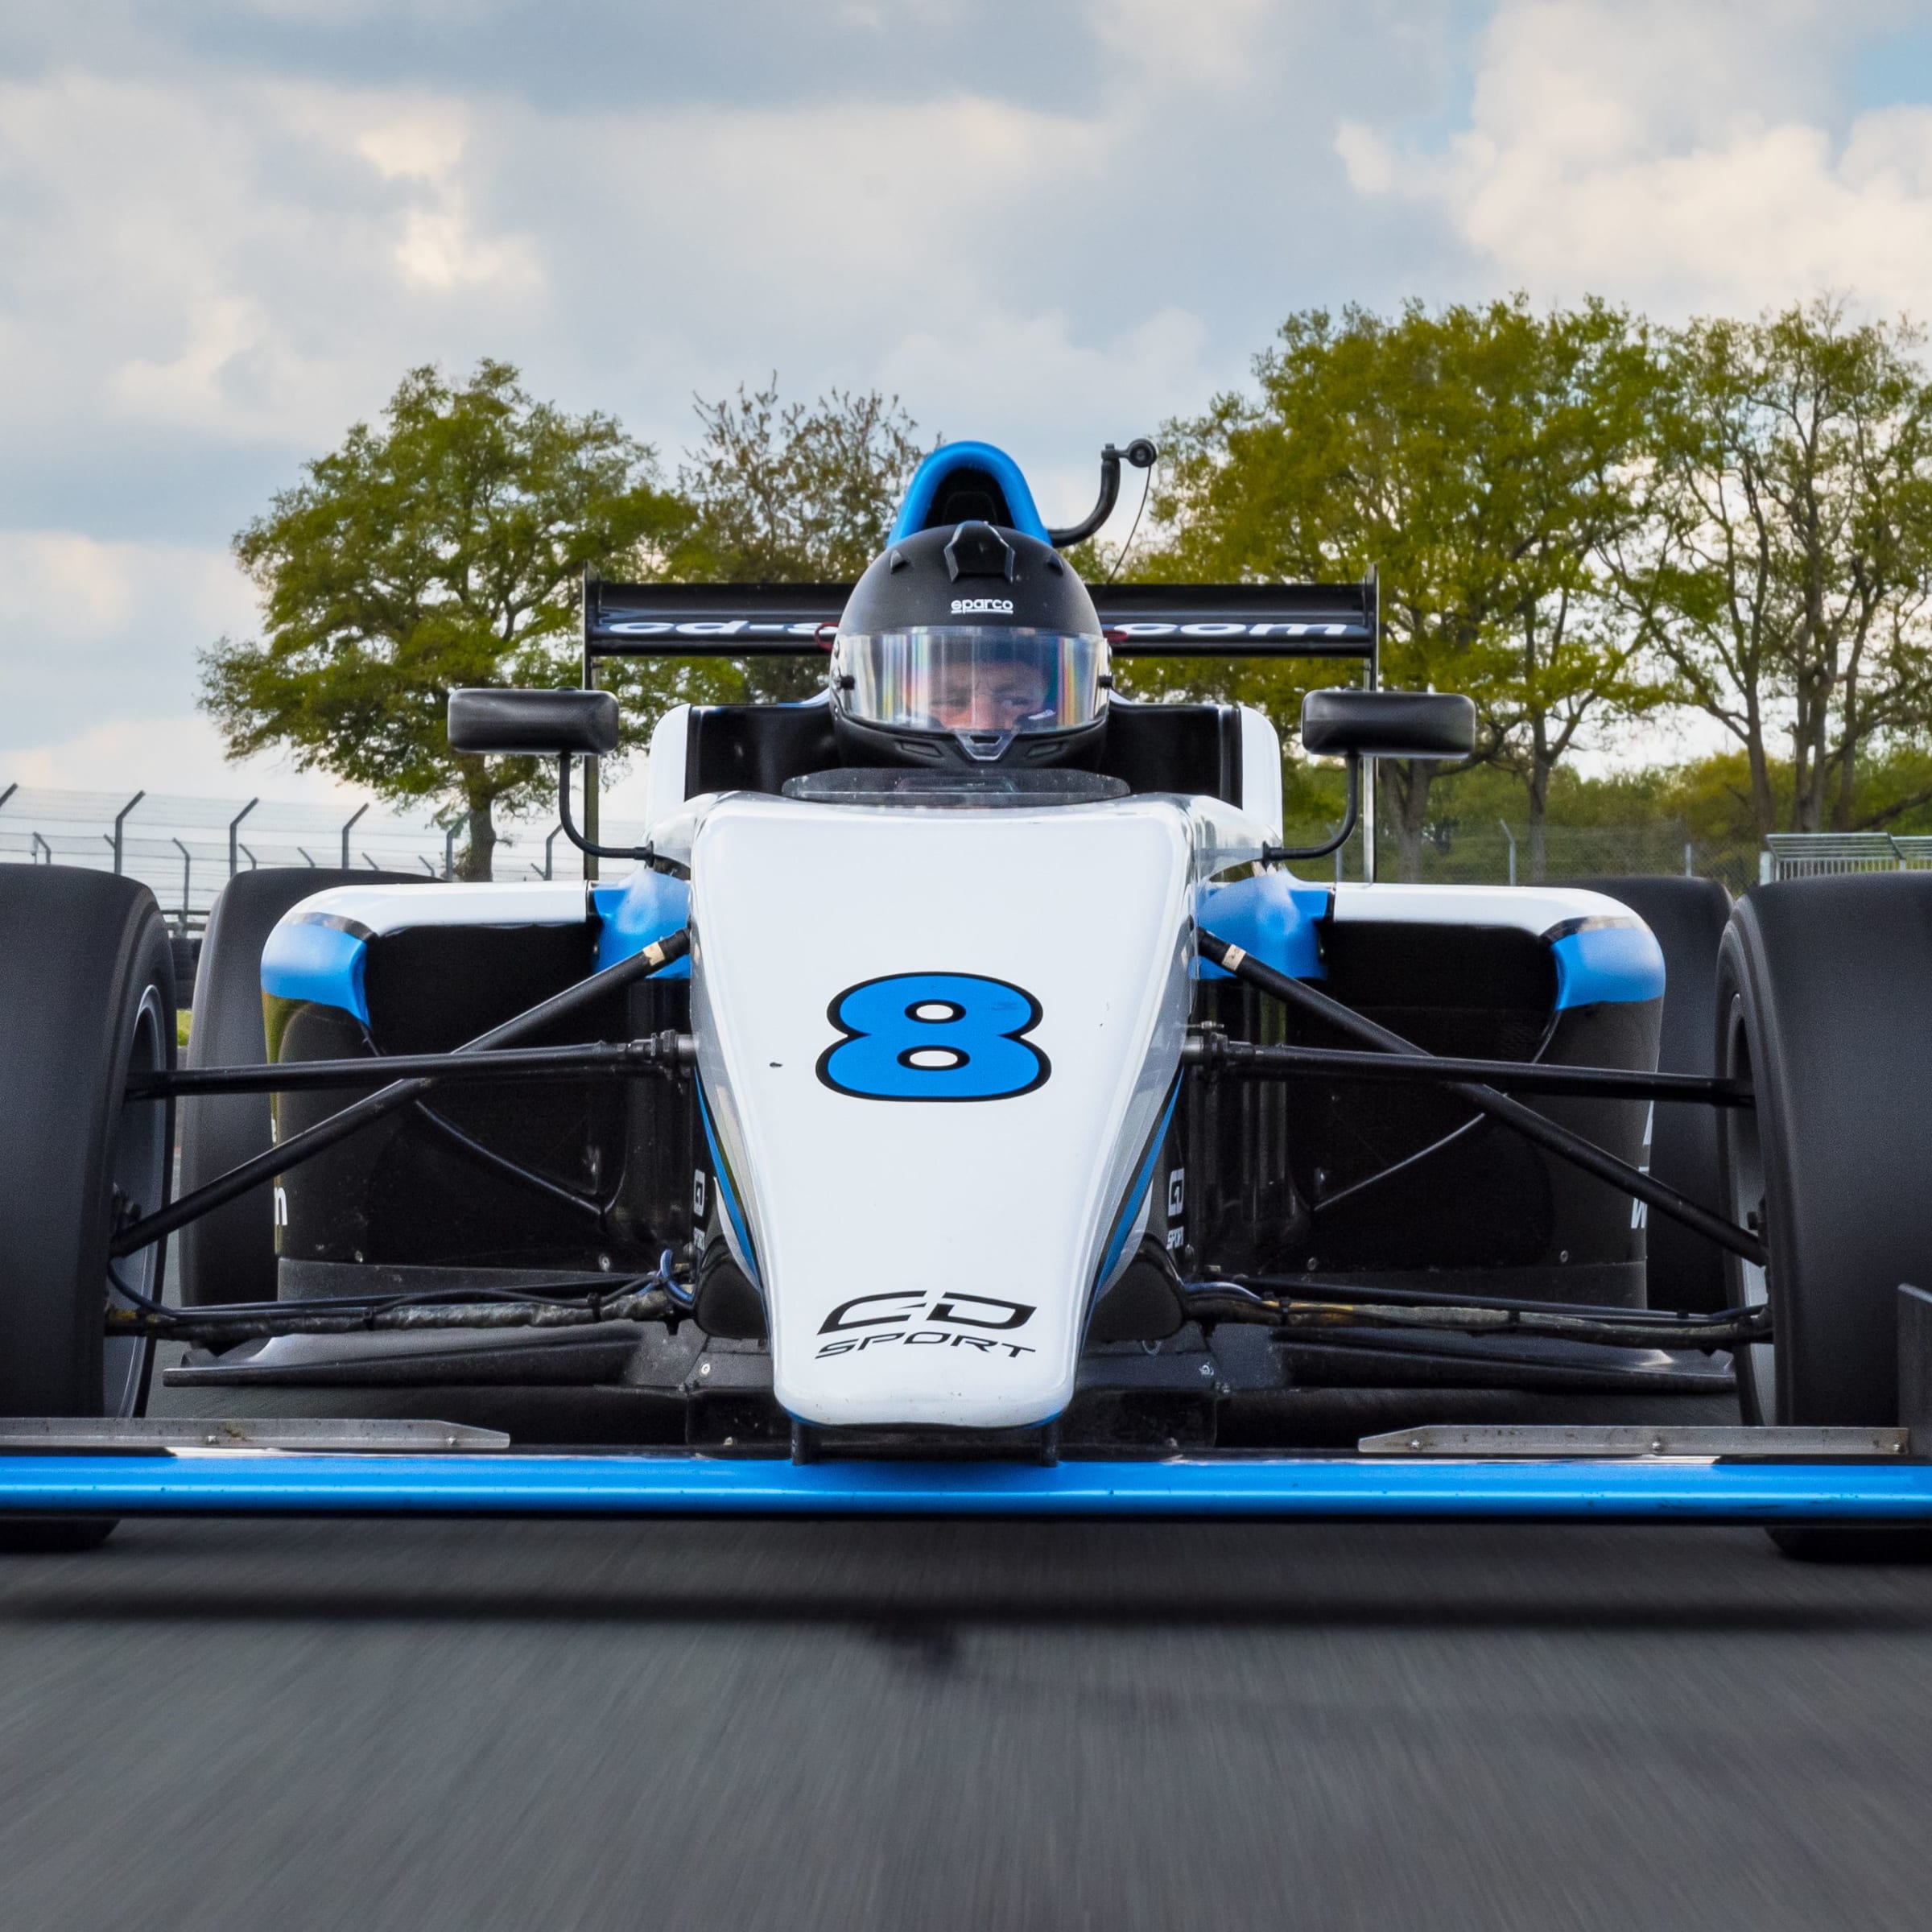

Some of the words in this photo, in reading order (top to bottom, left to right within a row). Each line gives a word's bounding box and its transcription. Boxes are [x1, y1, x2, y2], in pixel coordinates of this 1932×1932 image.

[951, 599, 1013, 614] sparco
[815, 971, 1052, 1103] 8
[816, 1290, 1038, 1335] CD
[815, 1331, 1036, 1360] SPORT
